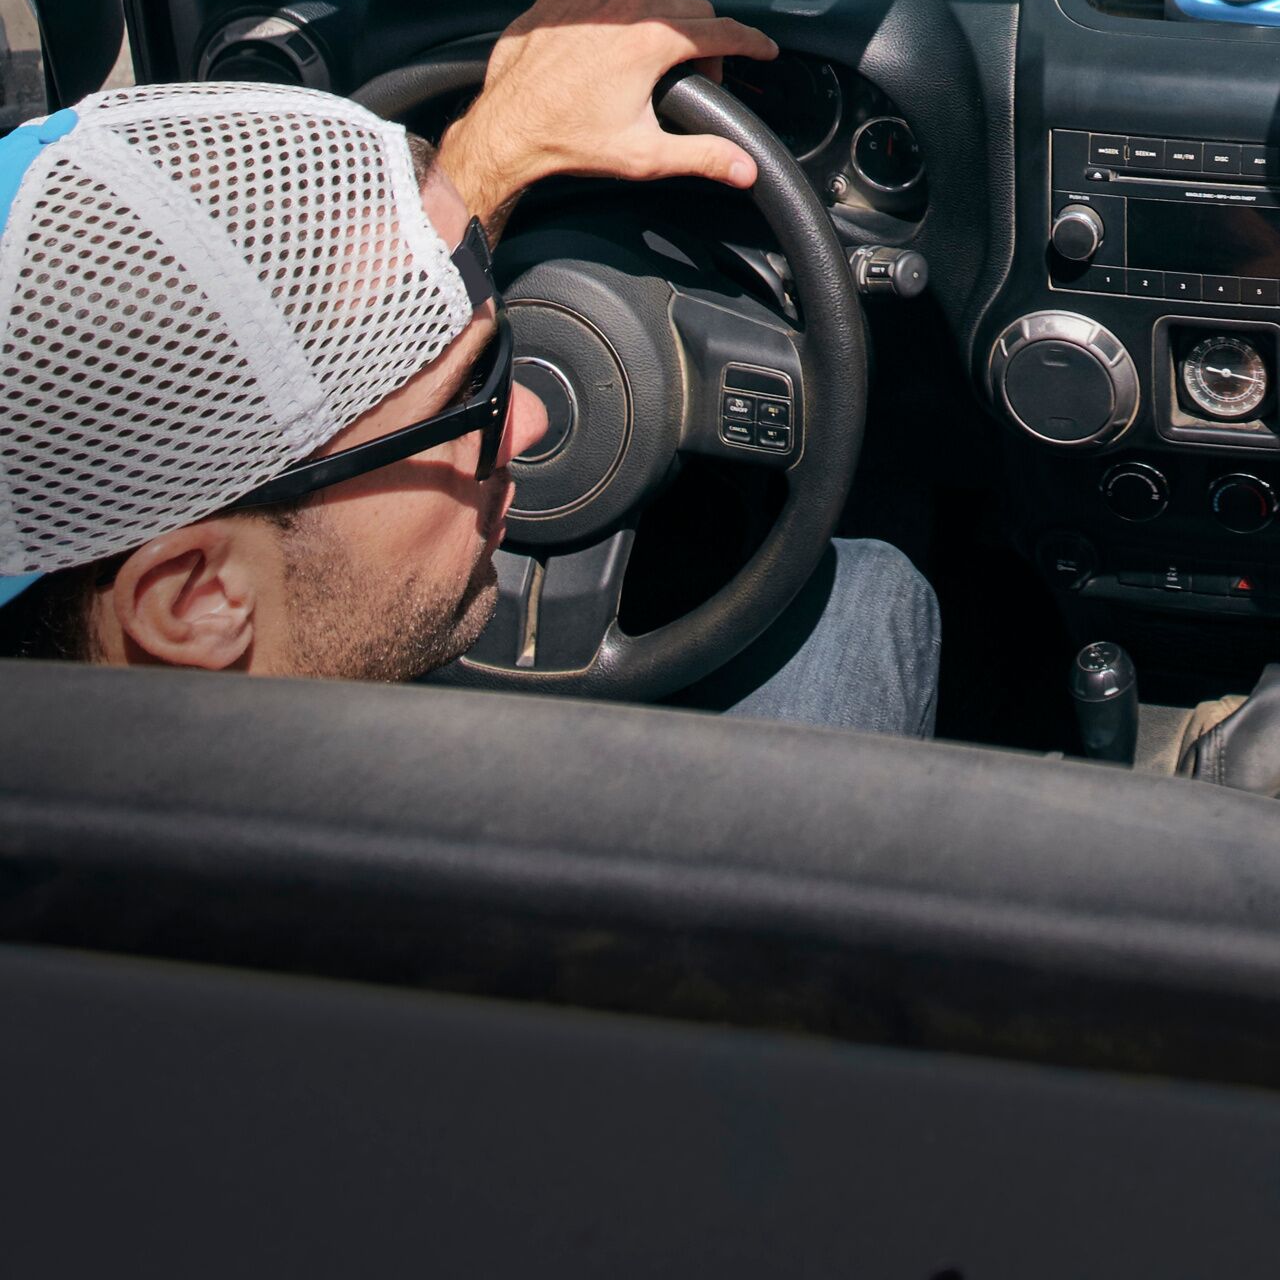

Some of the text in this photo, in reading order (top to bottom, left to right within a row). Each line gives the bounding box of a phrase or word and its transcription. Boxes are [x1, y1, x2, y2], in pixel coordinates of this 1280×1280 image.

[869, 141, 877, 150] C
[911, 144, 919, 152] H
[1214, 155, 1230, 163] DISC
[1142, 279, 1149, 287] 2
[1180, 282, 1186, 290] 3
